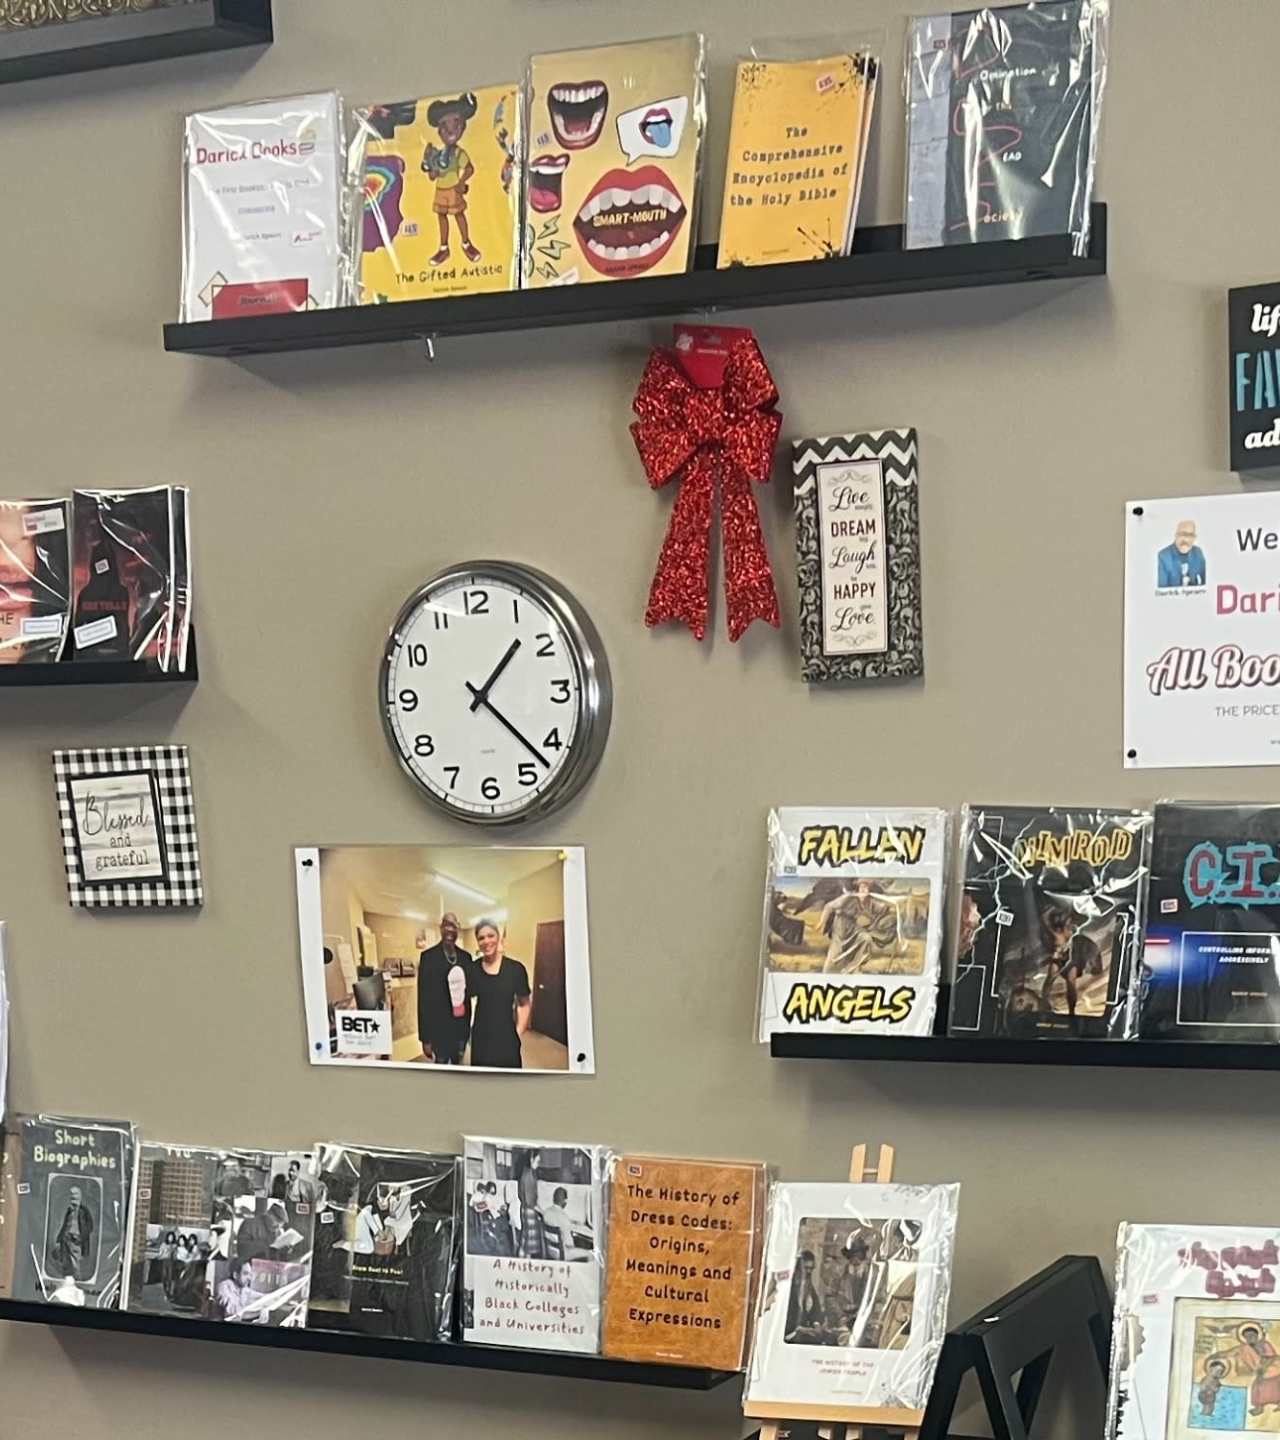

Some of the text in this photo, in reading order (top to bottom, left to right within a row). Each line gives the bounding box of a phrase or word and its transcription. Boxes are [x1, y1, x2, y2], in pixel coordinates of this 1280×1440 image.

[786, 126, 808, 138] The
[742, 144, 843, 163] Comprehensive
[732, 163, 849, 186] Encyclopedia of
[730, 187, 837, 207] the Holy Bible
[592, 208, 668, 228] SMART-MOUTH
[395, 264, 503, 284] The Gifted Autistic
[828, 485, 871, 513] Live
[830, 519, 877, 538] DREAM
[828, 539, 878, 574] Laugh
[463, 590, 490, 615] 12
[833, 582, 877, 601] HAPPY
[433, 612, 450, 630] 11
[512, 599, 520, 624] 1
[830, 606, 875, 632] Love
[407, 644, 429, 668] 10
[535, 633, 556, 657] 2
[1145, 645, 1207, 696] All
[399, 689, 419, 713] 9
[549, 679, 573, 704] 3
[1215, 706, 1239, 718] THE
[1242, 704, 1280, 717] PRICE
[414, 734, 434, 757] 8
[542, 728, 564, 752] 4
[443, 766, 461, 790] 7
[517, 763, 539, 787] 5
[481, 777, 501, 801] 6
[82, 790, 152, 836] Blessed
[110, 832, 132, 848] and
[798, 825, 925, 867] FALLEN
[1012, 829, 1134, 868] NIMROD
[95, 849, 151, 872] grateful
[782, 982, 916, 1024] ANGELS
[341, 1015, 371, 1035] BET
[55, 1129, 96, 1148] Short
[32, 1145, 116, 1170] Biographies
[627, 1185, 741, 1207] The History of
[630, 1210, 733, 1231] Dress Codes:
[649, 1235, 711, 1256] Origins,
[492, 1259, 572, 1278] A History of
[626, 1258, 732, 1282] Meanings and
[494, 1278, 570, 1299] Historically
[644, 1284, 710, 1304] Cultural
[484, 1297, 580, 1318] Black Colleges
[628, 1308, 722, 1330] Expressions
[479, 1316, 585, 1337] and Universities
